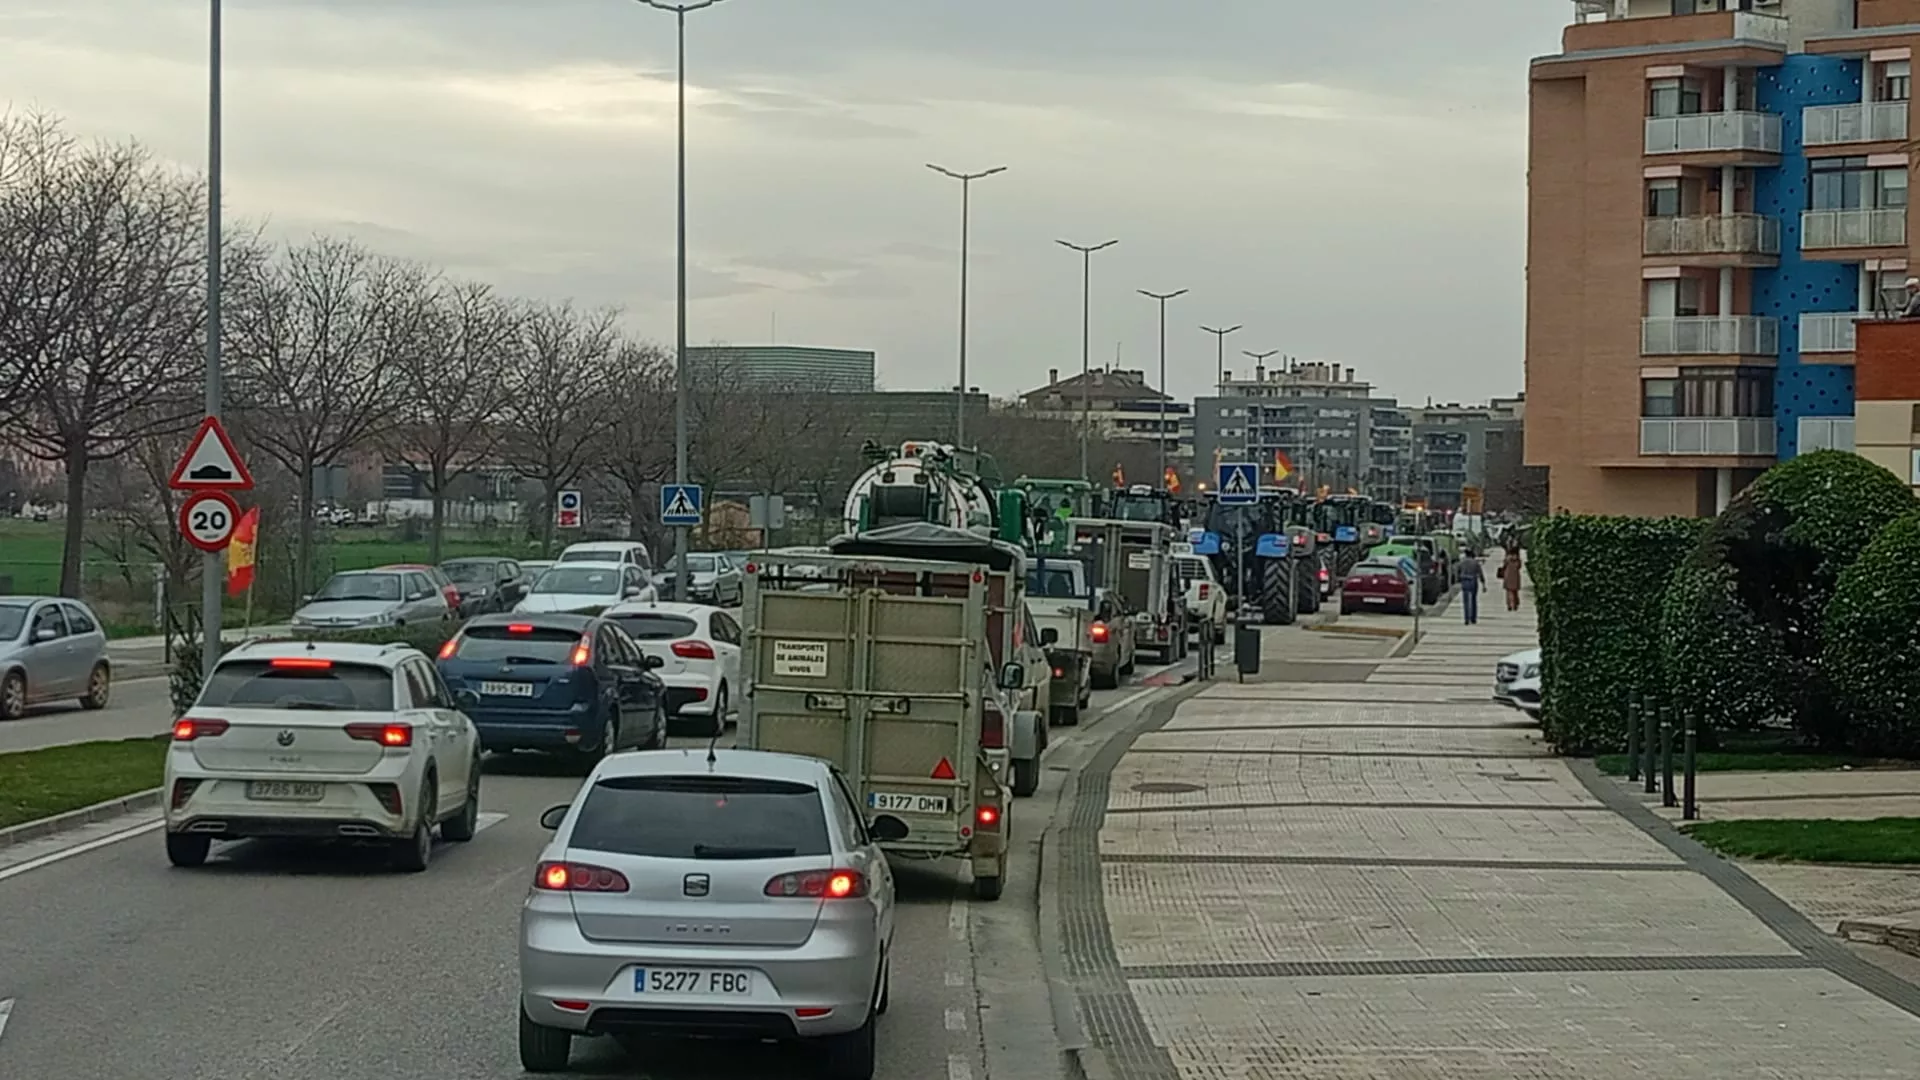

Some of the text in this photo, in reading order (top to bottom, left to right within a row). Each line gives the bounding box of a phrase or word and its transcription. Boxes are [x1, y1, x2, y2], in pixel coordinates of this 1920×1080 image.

[193, 511, 226, 530] 20
[778, 643, 824, 651] TRANSPORTE
[776, 653, 825, 663] DE ANIMALES
[879, 795, 944, 811] 9177 DHW
[651, 971, 748, 992] 5277 FBC
